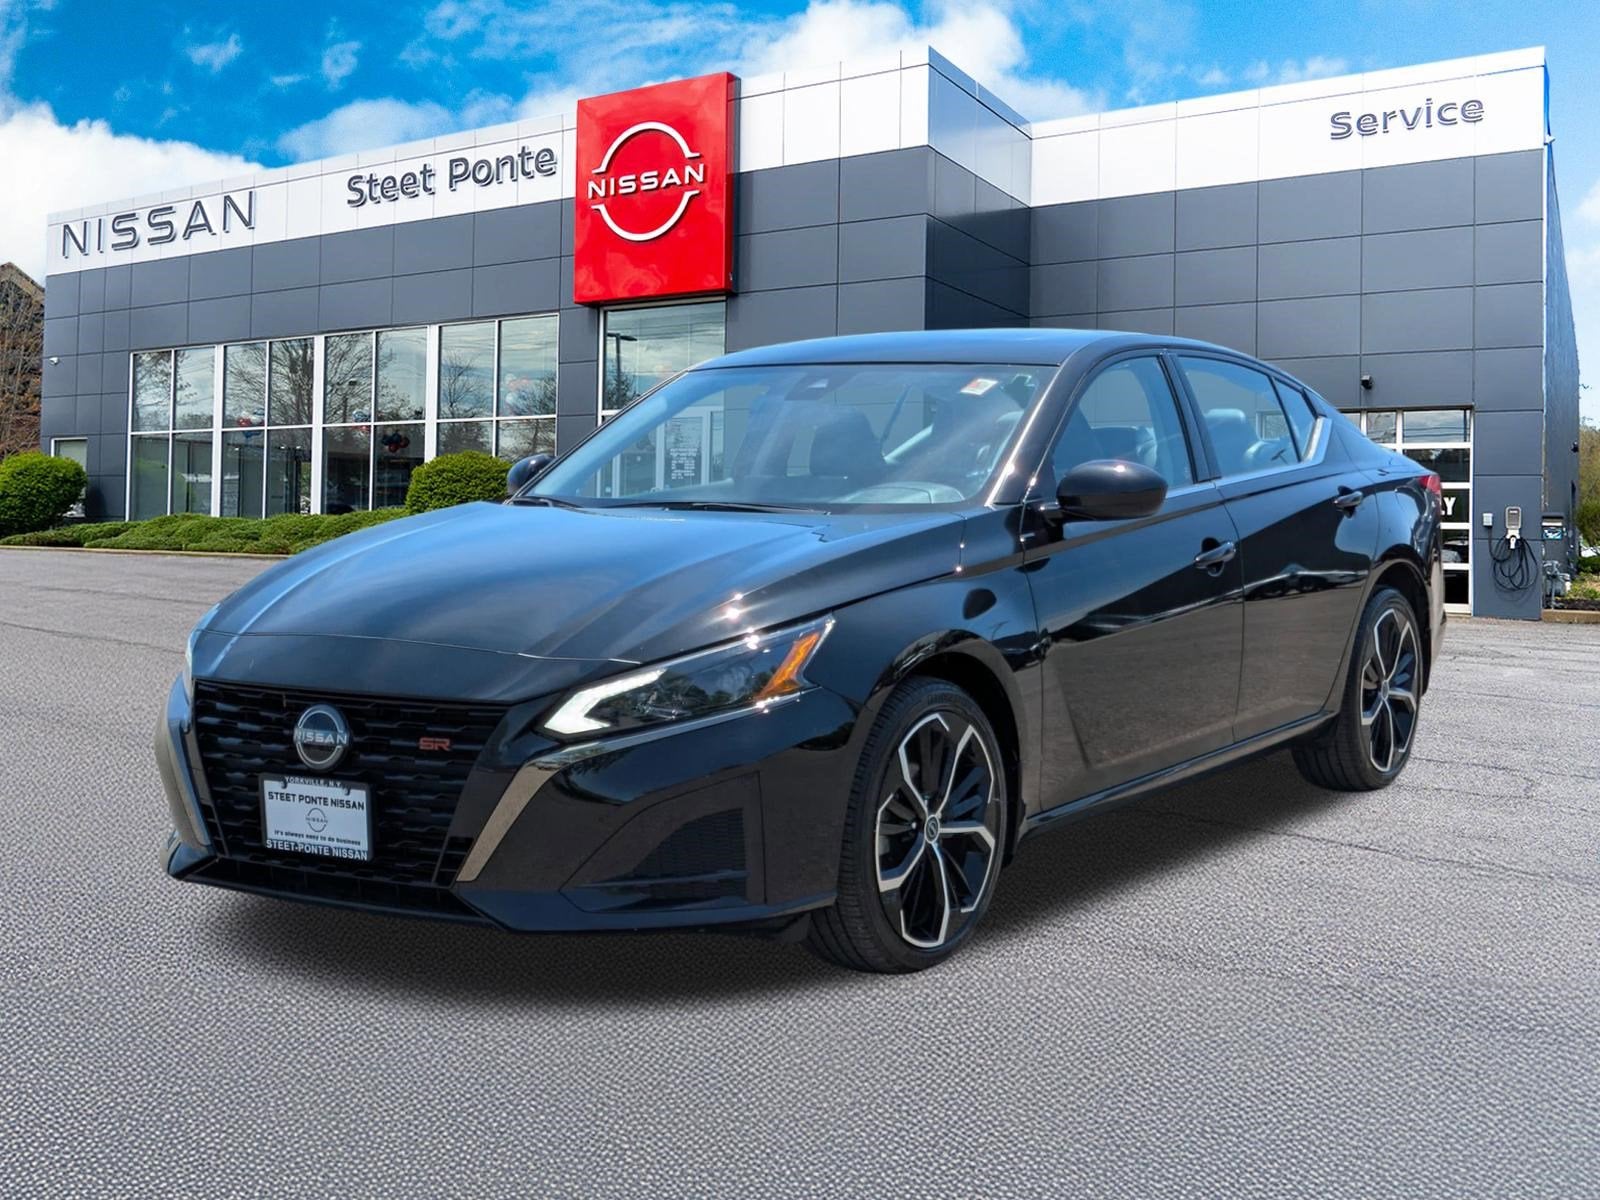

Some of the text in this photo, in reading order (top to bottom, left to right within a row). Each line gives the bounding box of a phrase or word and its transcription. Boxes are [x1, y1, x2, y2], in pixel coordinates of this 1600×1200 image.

[1330, 98, 1485, 140] Service
[347, 146, 558, 207] Steet Ponte
[587, 163, 705, 200] NISSAN
[62, 191, 254, 258] NISSAN
[294, 729, 347, 745] NISSAN
[419, 737, 450, 751] SR
[268, 791, 364, 811] STEET PONTE NISSAN
[336, 837, 361, 846] business
[332, 847, 368, 861] NISSAN
